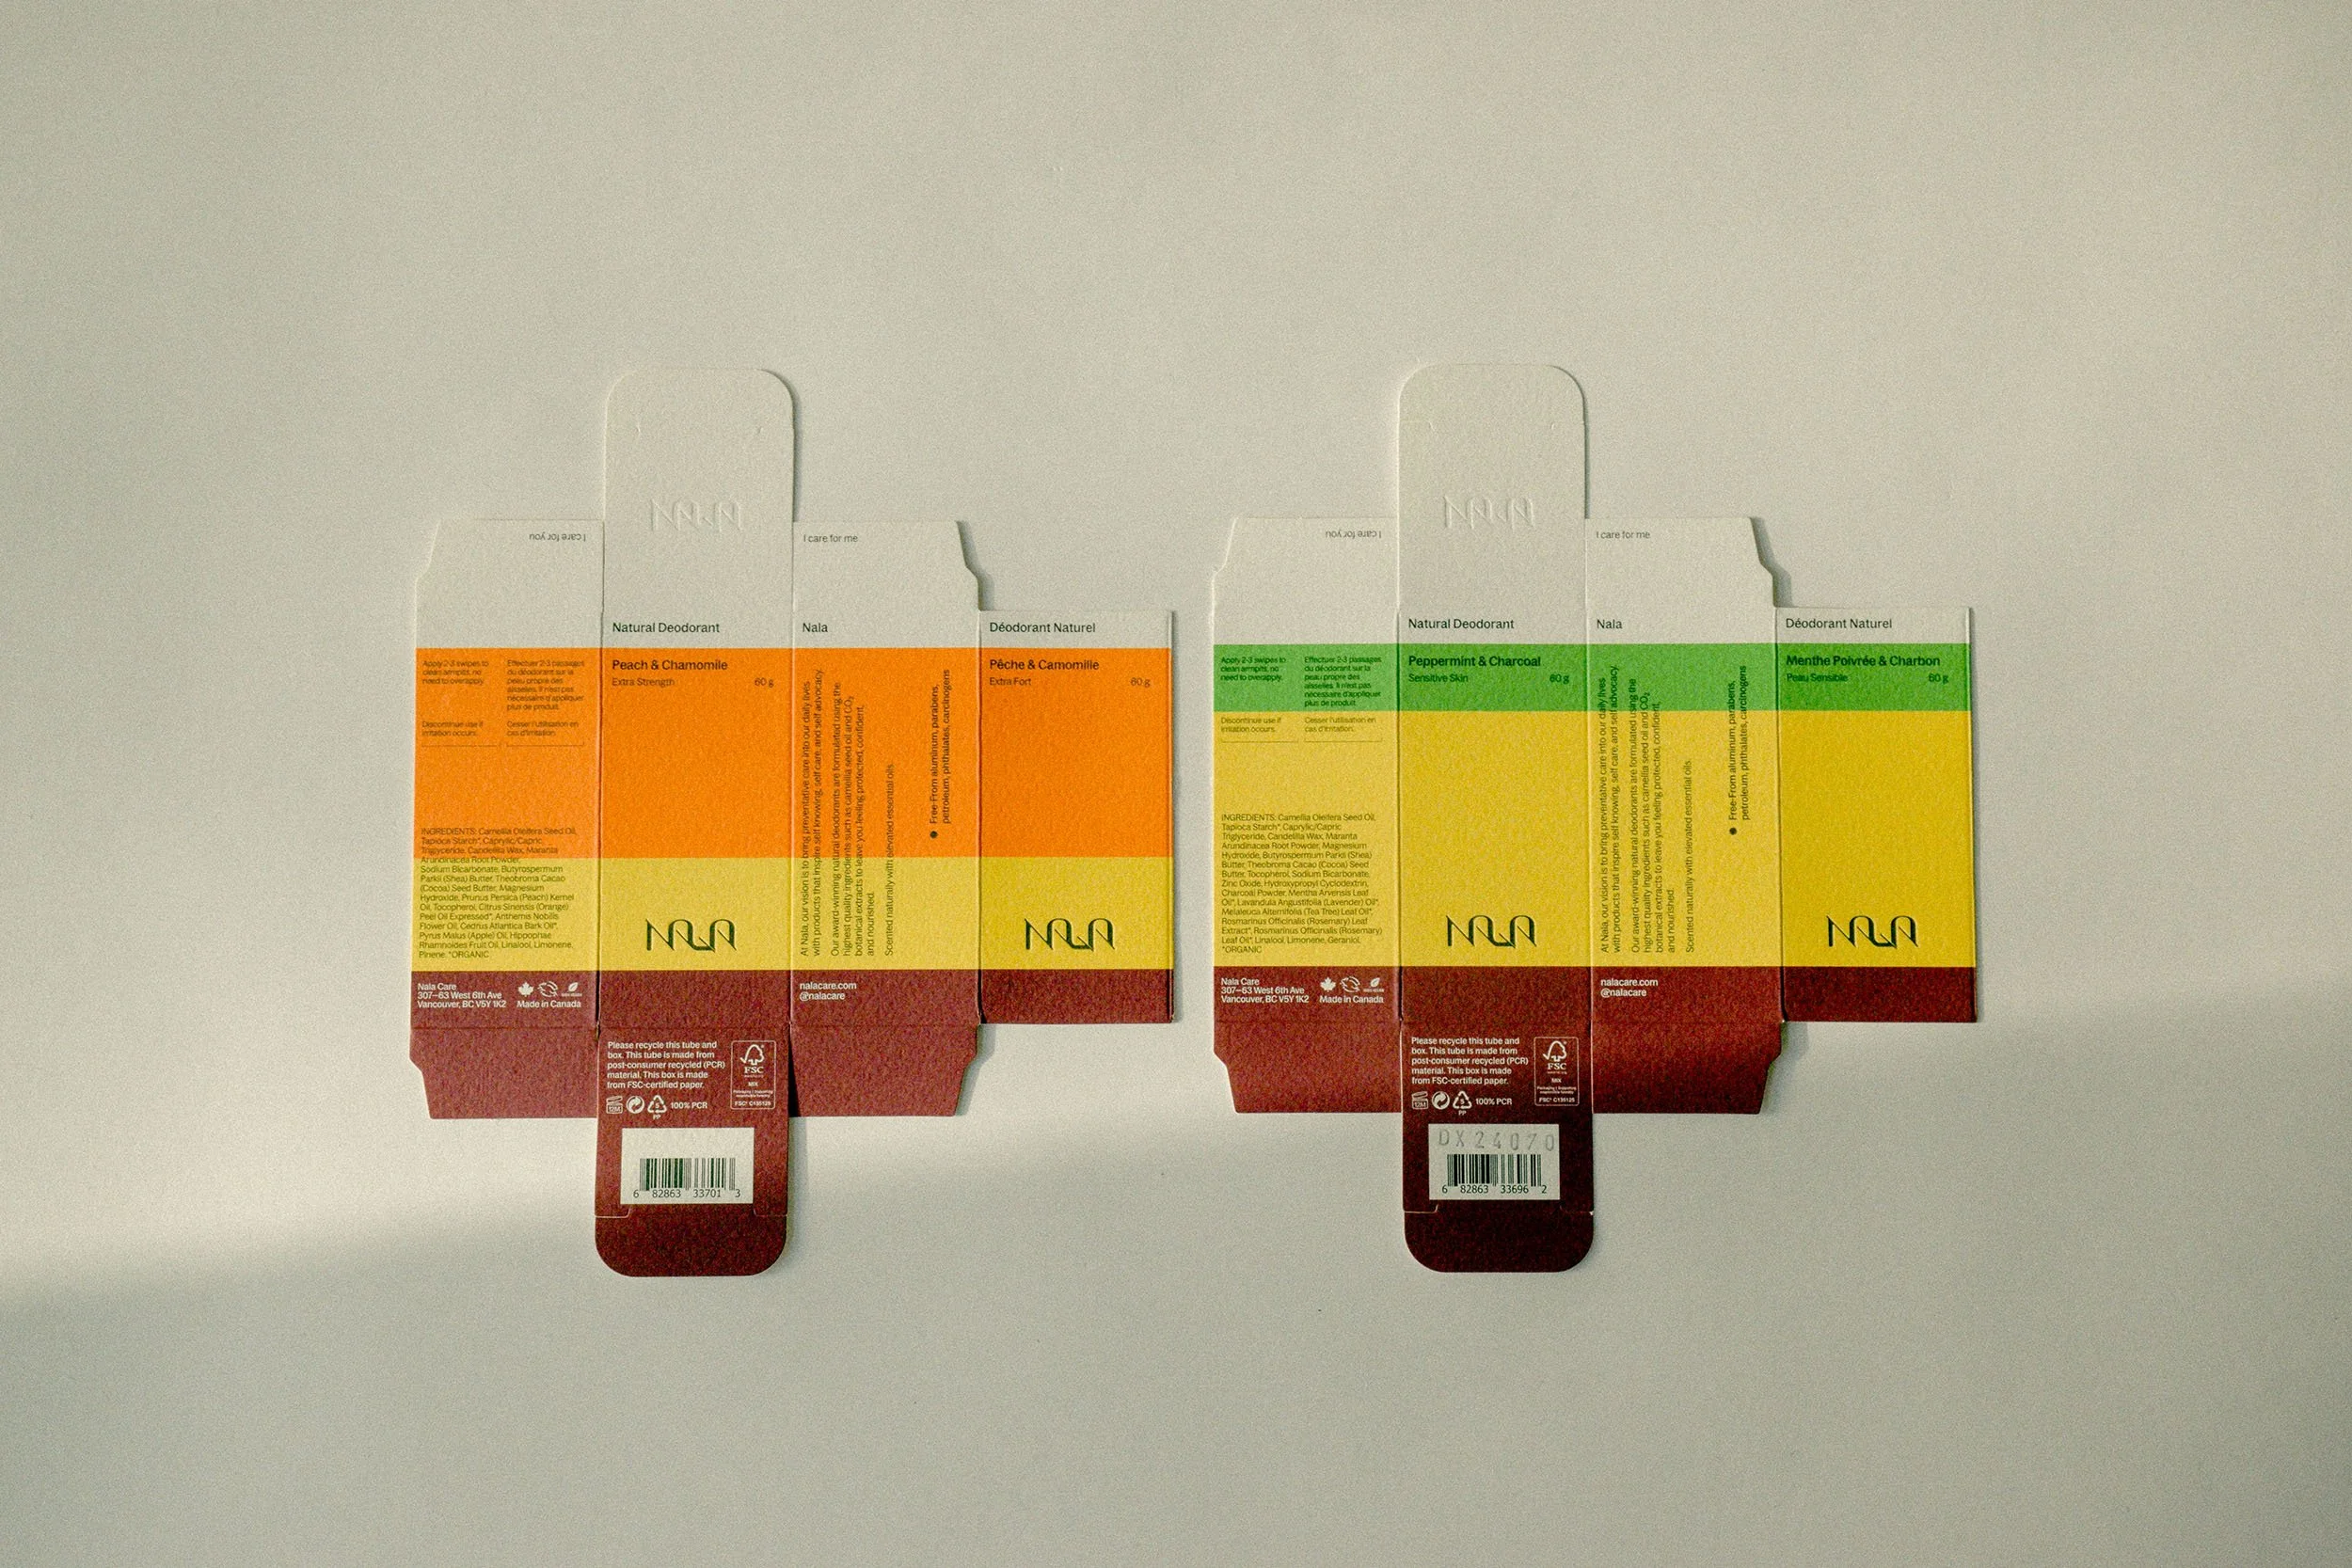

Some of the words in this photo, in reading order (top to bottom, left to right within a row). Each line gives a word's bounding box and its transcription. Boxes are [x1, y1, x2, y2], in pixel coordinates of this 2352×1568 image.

[529, 531, 546, 540] you
[548, 533, 560, 542] for
[583, 533, 586, 542] I
[830, 534, 842, 543] for
[1326, 529, 1342, 538] you
[1343, 531, 1356, 539] for
[1379, 531, 1382, 539] I
[1622, 531, 1634, 539] for
[612, 623, 656, 633] Natural
[659, 623, 720, 633] Deodorant
[803, 623, 828, 633] Nala
[990, 622, 1051, 633] Déodorant
[1054, 623, 1095, 633] Naturel
[1408, 618, 1451, 628] Natural
[1454, 618, 1514, 629] Deodorant
[1597, 619, 1623, 629] Nala
[1786, 618, 1847, 628] Déodorant
[1850, 618, 1892, 628] Naturel
[612, 659, 648, 670] Peach
[650, 659, 660, 671] &
[661, 659, 728, 671] Chamomile
[990, 658, 1025, 670] Pêche
[1027, 659, 1036, 670] &
[1038, 659, 1100, 670] Camomille
[1408, 656, 1476, 669] Peppermint
[1478, 656, 1487, 667] &
[1488, 656, 1541, 667] Charcoal
[1786, 655, 1831, 666] Menthe
[1833, 655, 1876, 667] Poivrée
[1878, 656, 1887, 666] &
[1889, 656, 1940, 666] Charbon
[612, 676, 635, 687] Extra
[637, 677, 675, 689] Strength
[755, 677, 768, 687] 60
[769, 679, 774, 689] g
[989, 677, 1012, 686] Extra
[1013, 677, 1031, 686] Fort
[1130, 677, 1143, 687] 60
[1144, 679, 1151, 689] g
[1408, 673, 1448, 683] Sensitive
[1449, 673, 1469, 683] Skin
[1549, 673, 1562, 683] 60
[1563, 675, 1569, 685] g
[1787, 673, 1809, 683] Peau
[1810, 673, 1849, 682] Sensible
[1928, 673, 1942, 683] 60
[1942, 675, 1949, 685] g
[942, 669, 952, 723] carcinogens
[1739, 665, 1749, 720] carcinogens
[930, 779, 938, 824] Free-From
[799, 992, 846, 1001] @nalacare
[1600, 989, 1646, 998] @nalacare
[417, 1001, 461, 1009] Vancouver,
[1221, 995, 1264, 1005] Vancouver,
[1438, 1037, 1468, 1047] recycle
[1411, 1057, 1470, 1067] post-consumer
[1471, 1057, 1506, 1067] recycled
[1506, 1057, 1529, 1066] (PCR)
[1548, 1061, 1566, 1069] FSC
[744, 1065, 764, 1073] FSC
[633, 1189, 640, 1198] 6
[652, 1189, 681, 1198] 82863
[693, 1189, 721, 1198] 33701
[735, 1189, 741, 1198] 3
[1441, 1185, 1448, 1195] 6
[1460, 1185, 1489, 1195] 82863
[1501, 1185, 1529, 1195] 33696
[1541, 1185, 1548, 1195] 2
